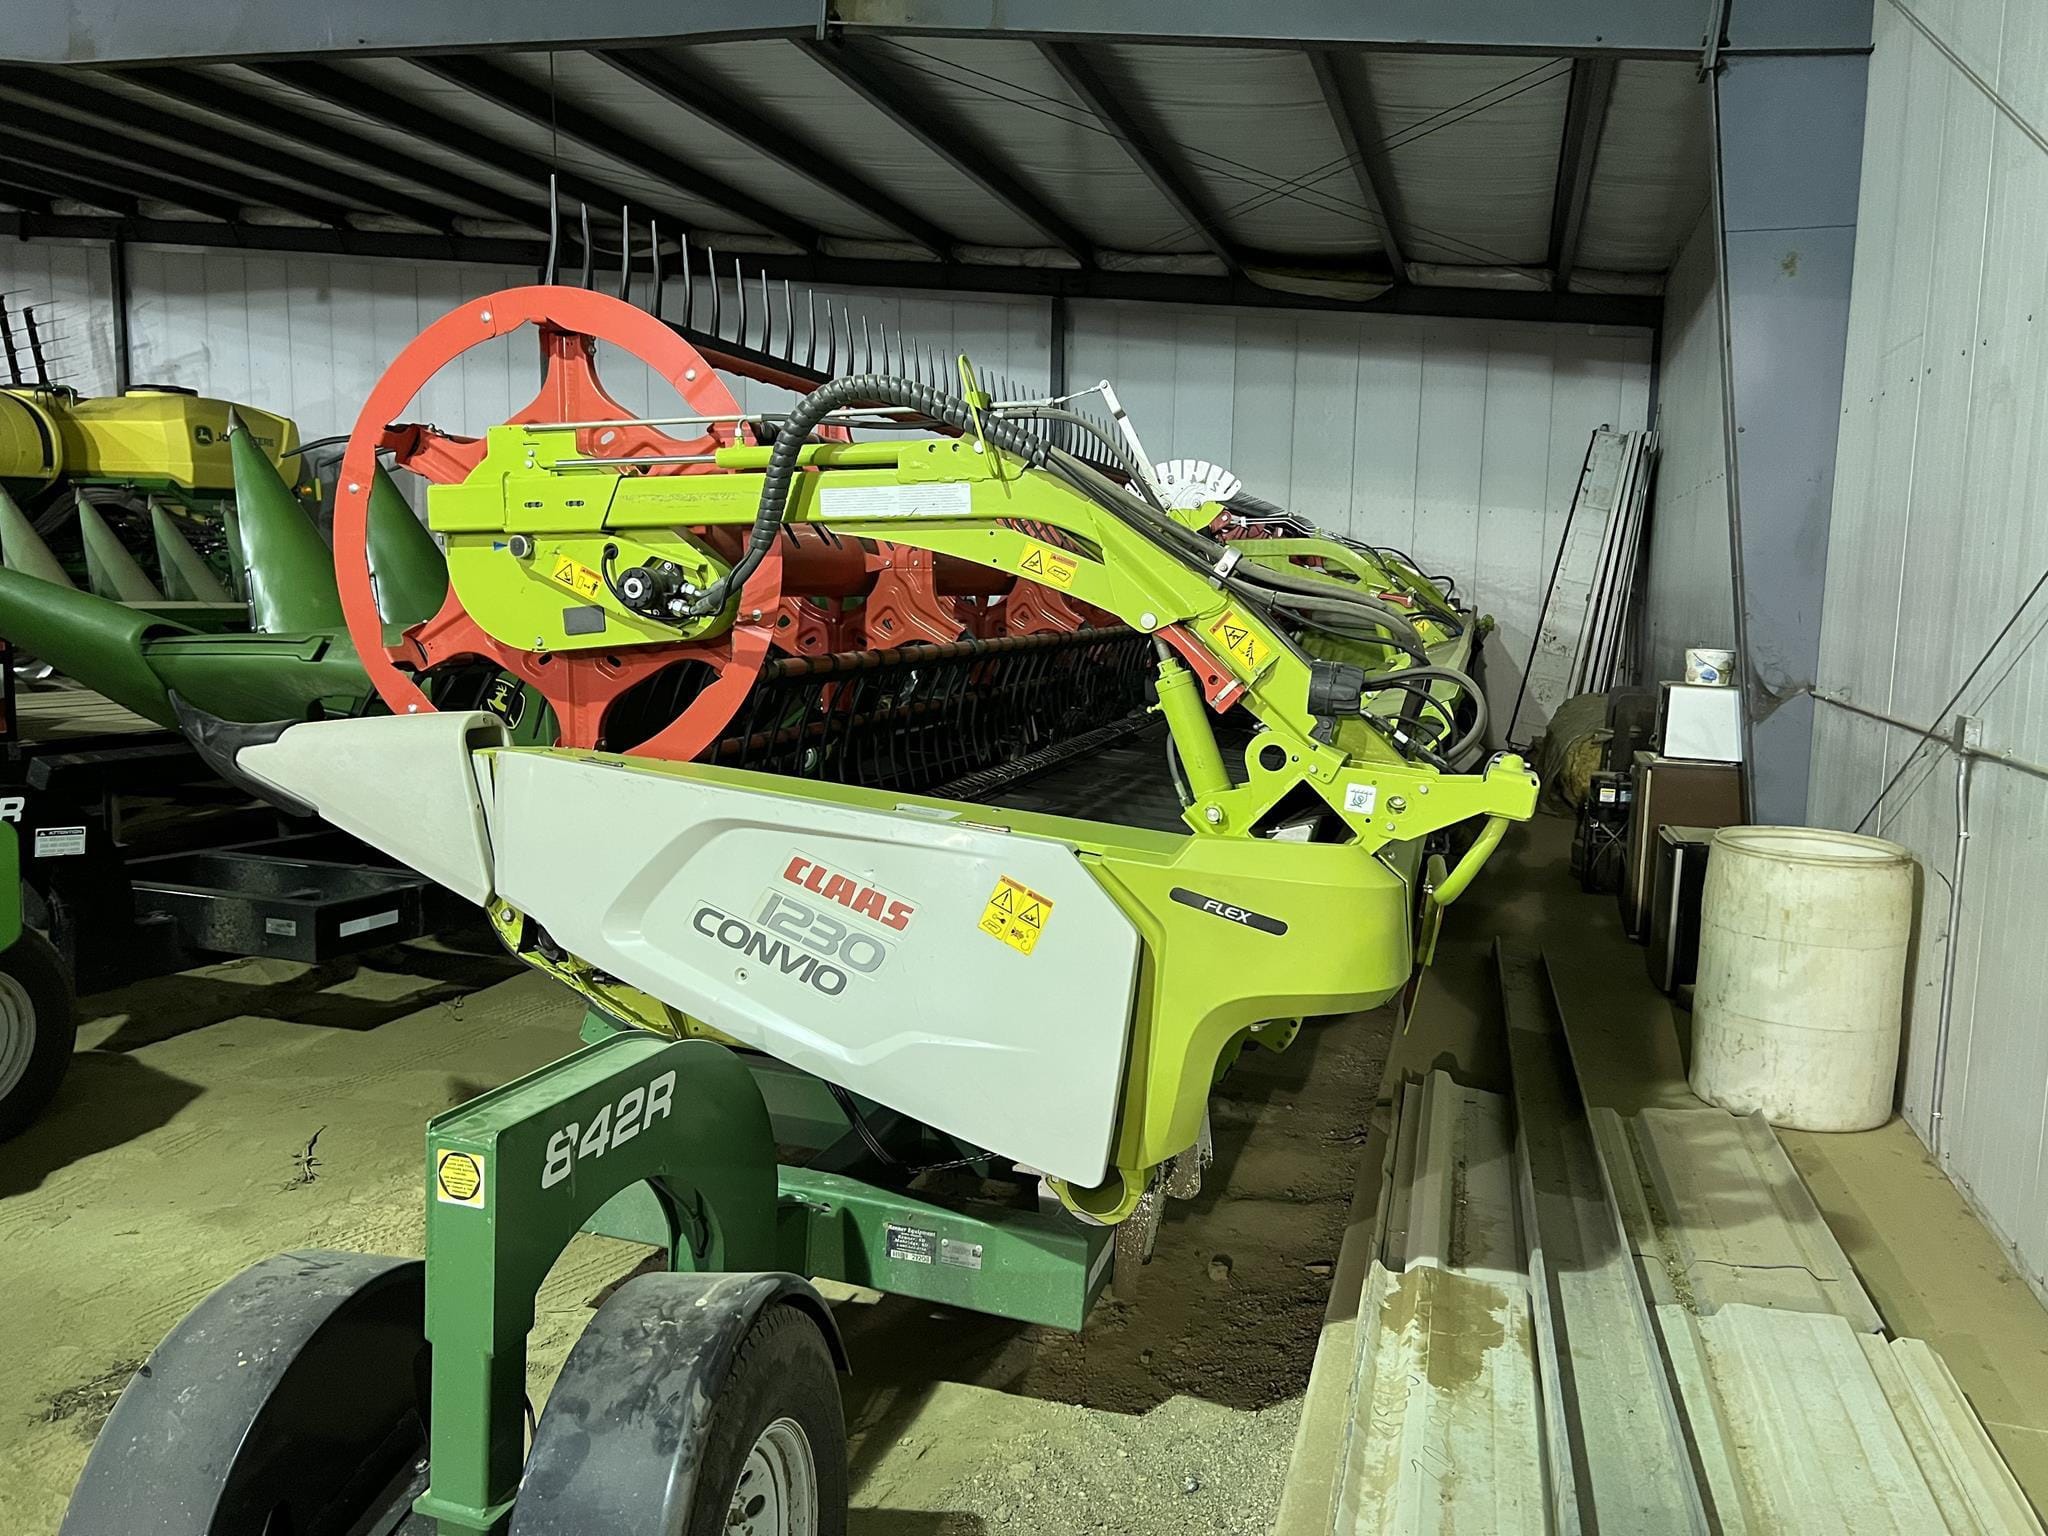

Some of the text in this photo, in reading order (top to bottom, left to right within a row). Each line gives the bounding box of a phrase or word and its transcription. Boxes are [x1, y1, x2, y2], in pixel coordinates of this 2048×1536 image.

[756, 892, 886, 973] 1230
[783, 856, 914, 932] CLAAS
[1203, 900, 1252, 923] FLEX
[692, 907, 847, 996] CONVIO
[541, 1070, 676, 1189] 842R
